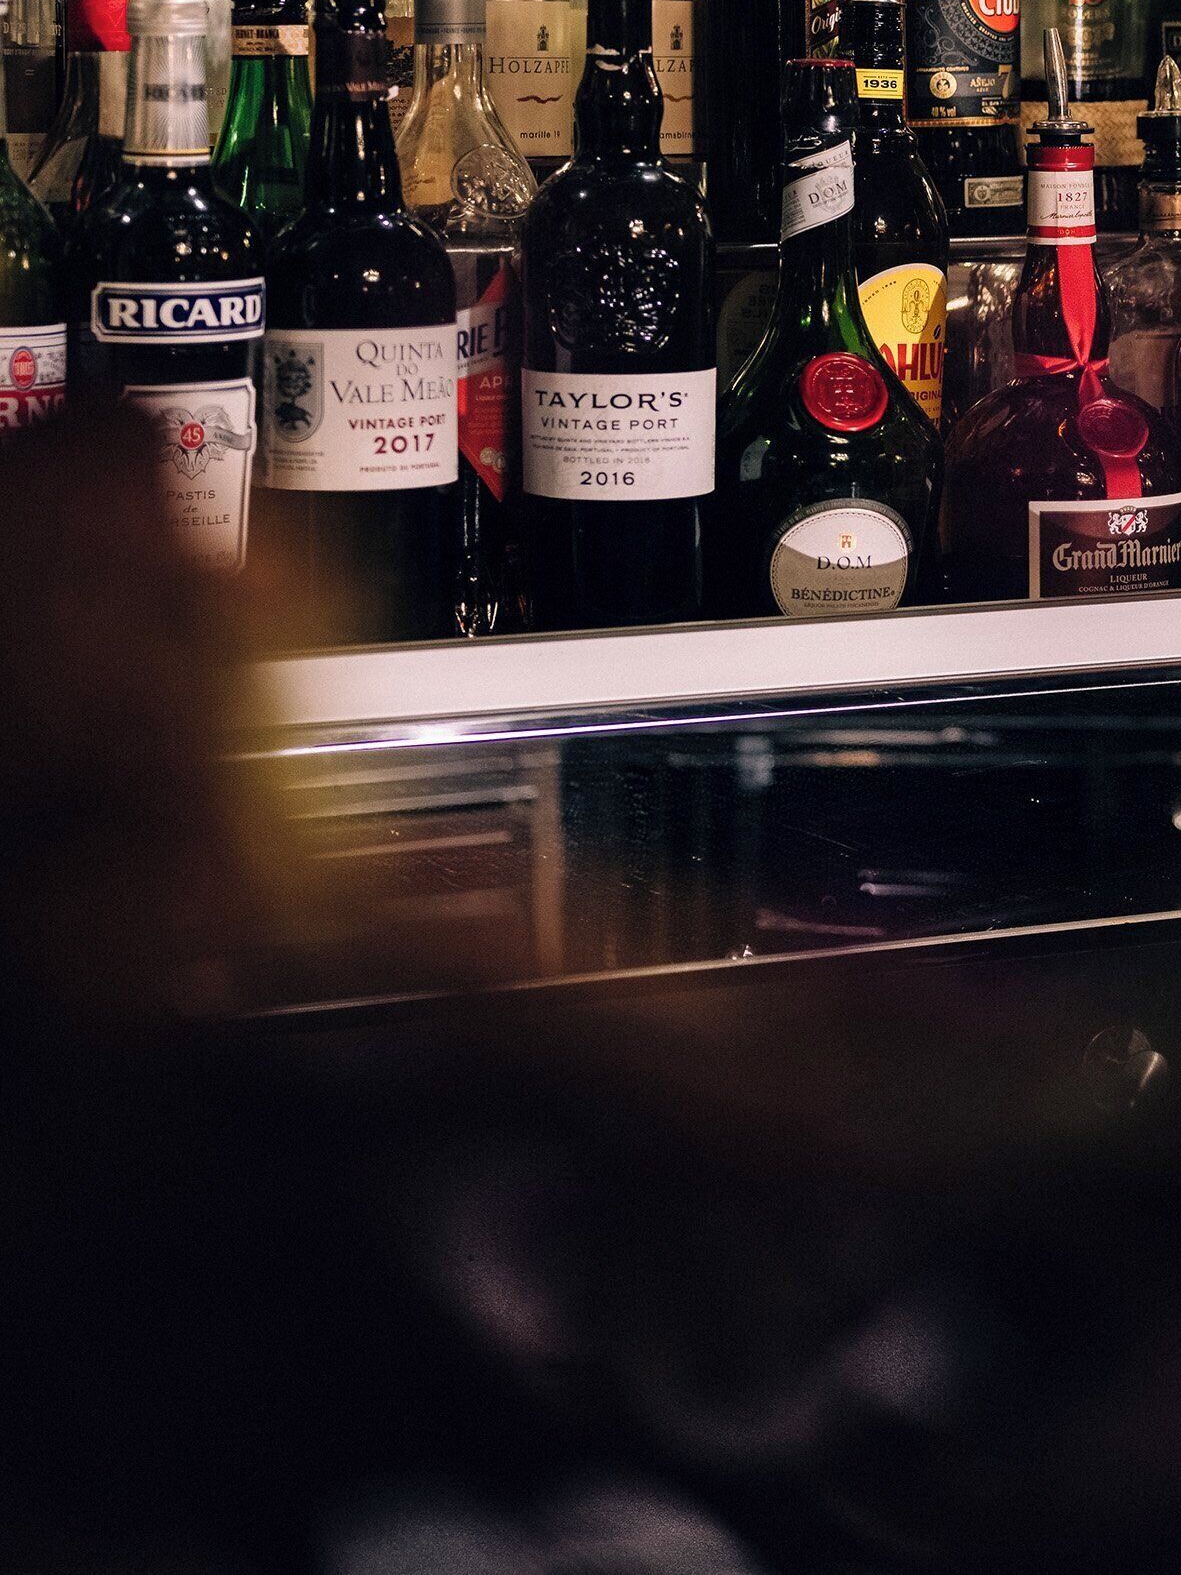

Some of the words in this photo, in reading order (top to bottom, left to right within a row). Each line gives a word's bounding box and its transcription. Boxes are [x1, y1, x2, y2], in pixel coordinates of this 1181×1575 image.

[863, 78, 898, 89] 1936
[519, 131, 551, 140] marille
[1058, 191, 1088, 203] 1827
[107, 294, 262, 328] RICARD
[356, 339, 444, 368] QUINTA
[397, 363, 419, 376] DO
[330, 381, 395, 404] VALE
[535, 390, 683, 412] TAYLOR'S
[348, 417, 415, 431] VINTAGE
[420, 413, 446, 427] PORT
[541, 417, 621, 431] VINTAGE
[629, 418, 679, 430] PORT
[182, 428, 201, 442] 45
[374, 434, 436, 455] 2017
[563, 456, 609, 464] BOTTLED
[580, 471, 636, 486] 2016
[166, 489, 216, 502] PASTIS
[182, 504, 198, 514] de
[1052, 541, 1117, 572] Grand
[1110, 574, 1148, 583] LIQUEUR
[791, 586, 891, 602] BÉNÉDICTINE
[1078, 585, 1108, 593] COGNAC
[1115, 582, 1144, 591] LIQUEUR
